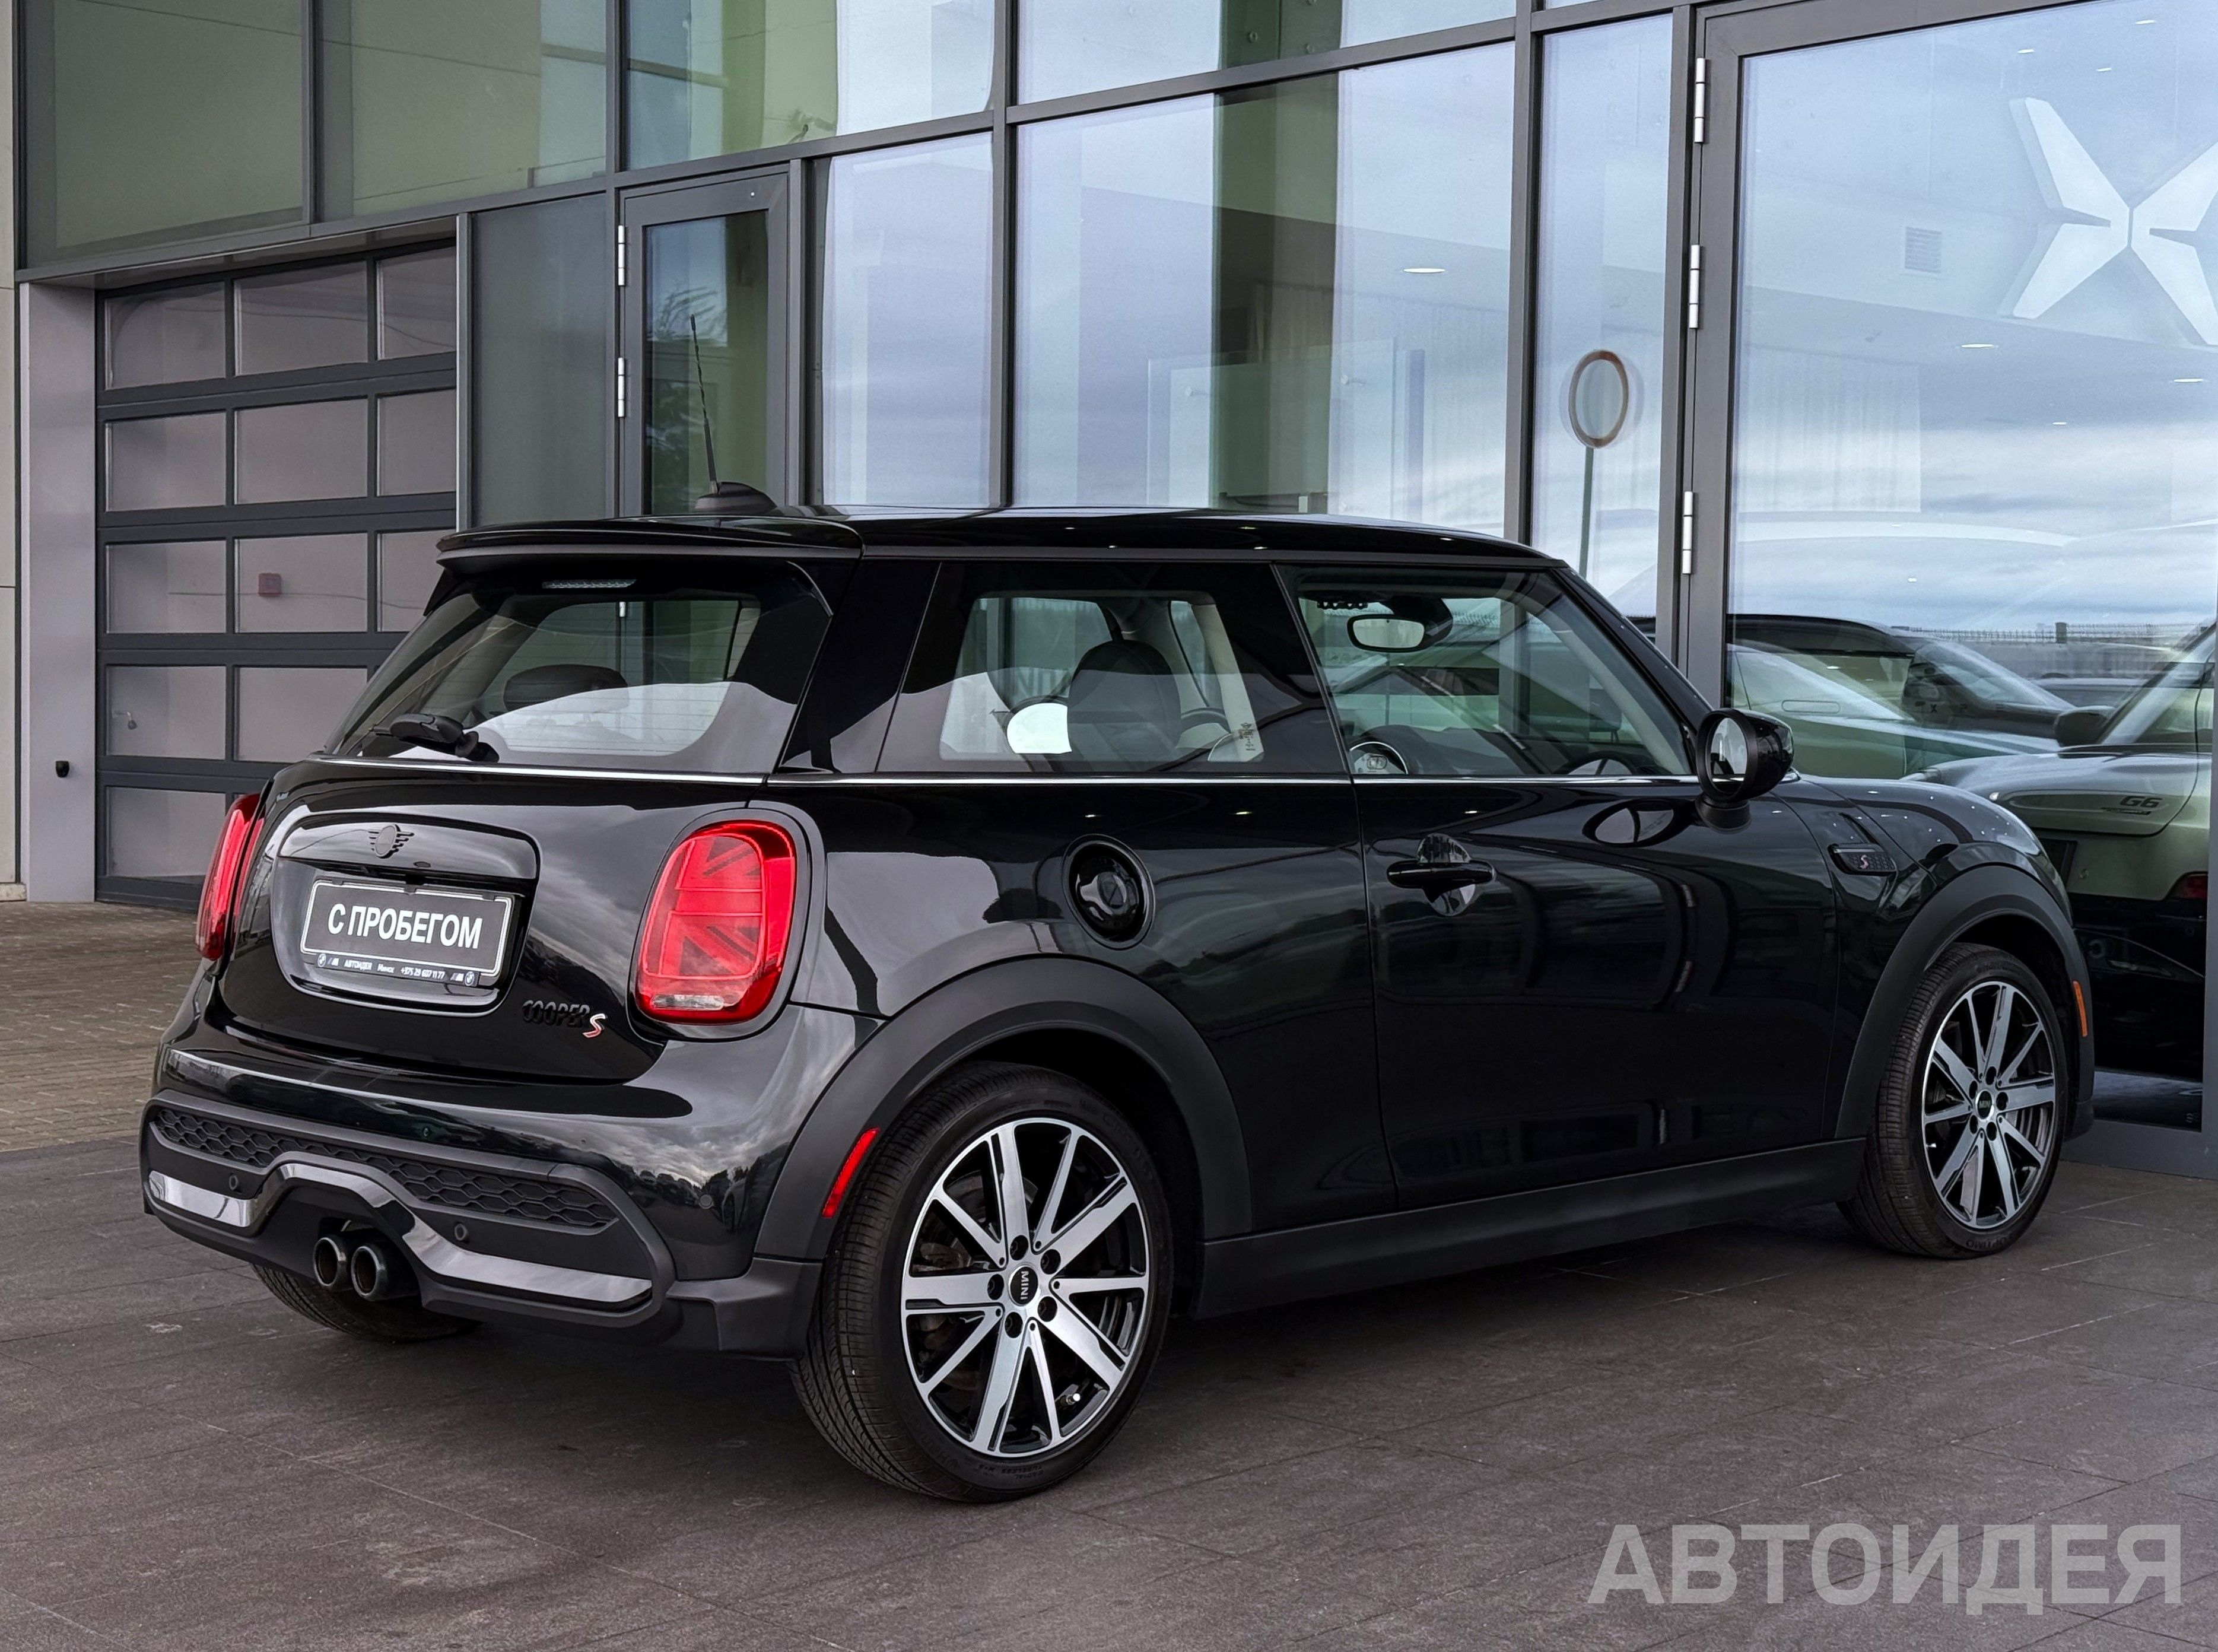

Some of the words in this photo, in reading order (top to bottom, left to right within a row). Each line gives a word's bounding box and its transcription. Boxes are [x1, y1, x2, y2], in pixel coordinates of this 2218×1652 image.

[2120, 796, 2163, 808] G6
[328, 904, 346, 935] С
[347, 906, 483, 949] ПРОБЕГОМ
[522, 999, 590, 1027] COOPER
[582, 1012, 606, 1038] S
[1979, 1100, 1991, 1109] MINI
[1020, 1270, 1029, 1300] MINI
